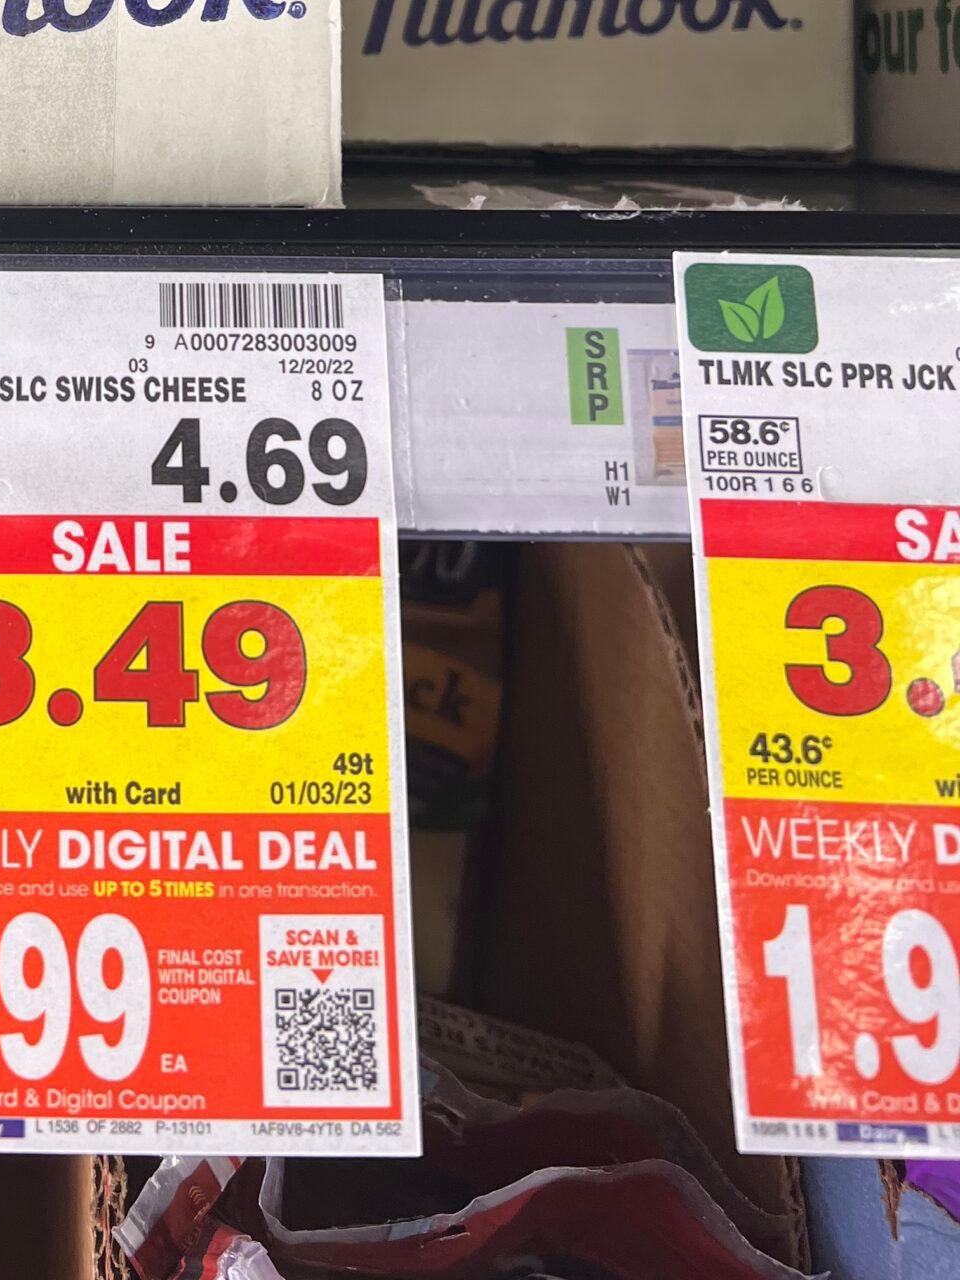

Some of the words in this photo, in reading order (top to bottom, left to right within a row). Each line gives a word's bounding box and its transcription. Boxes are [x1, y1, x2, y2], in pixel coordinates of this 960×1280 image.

[145, 334, 155, 350] 9
[175, 334, 358, 352] A0007283003009
[128, 359, 149, 373] 03
[278, 359, 355, 375] 12/20/22
[698, 359, 775, 387] TLMK
[783, 361, 833, 388] SLC
[841, 363, 893, 389] PPR
[902, 364, 957, 390] JCK
[0, 376, 47, 403] SLC
[55, 376, 136, 403] SWISS
[143, 376, 247, 403] CHEESE
[311, 380, 323, 402] 8
[332, 380, 364, 402] OZ
[150, 417, 369, 507] 4.69
[707, 450, 738, 467] PER
[743, 451, 799, 468] OUNCE
[605, 460, 630, 482] H1
[704, 476, 758, 492] 100R
[606, 486, 631, 506] W1
[51, 520, 191, 573] SALE
[332, 752, 374, 776] 49t
[747, 767, 781, 787] PER
[784, 769, 844, 790] OUNCE
[65, 780, 118, 805] with
[124, 780, 182, 805] Card
[270, 780, 373, 806] 01/03/23
[58, 829, 243, 871] DIGITAL
[258, 830, 377, 870] DEAL
[741, 816, 918, 864] WEEKLY
[18, 878, 55, 897] and
[58, 882, 89, 897] use
[93, 879, 118, 897] UP
[121, 880, 145, 897] TO
[148, 878, 162, 897] 5
[164, 879, 215, 898] TIMES
[219, 880, 235, 898] in
[238, 883, 273, 899] one
[276, 881, 378, 900] transaction.
[285, 929, 341, 946] SCAN
[346, 930, 359, 946] &
[158, 949, 199, 966] FINAL
[203, 949, 243, 966] COST
[266, 949, 314, 967] SAVE
[317, 950, 380, 967] MORE!
[157, 967, 194, 985] WITH
[197, 968, 255, 986] DIGITAL
[158, 987, 222, 1005] COUPON
[160, 1054, 188, 1073] EA
[25, 1088, 41, 1109] &
[46, 1088, 117, 1113] Digital
[121, 1089, 206, 1114] Coupon
[863, 1091, 919, 1114] Card
[86, 1120, 107, 1134] OF
[155, 1120, 213, 1135] P-13101
[350, 1122, 372, 1136] DA
[376, 1122, 402, 1137] 562
